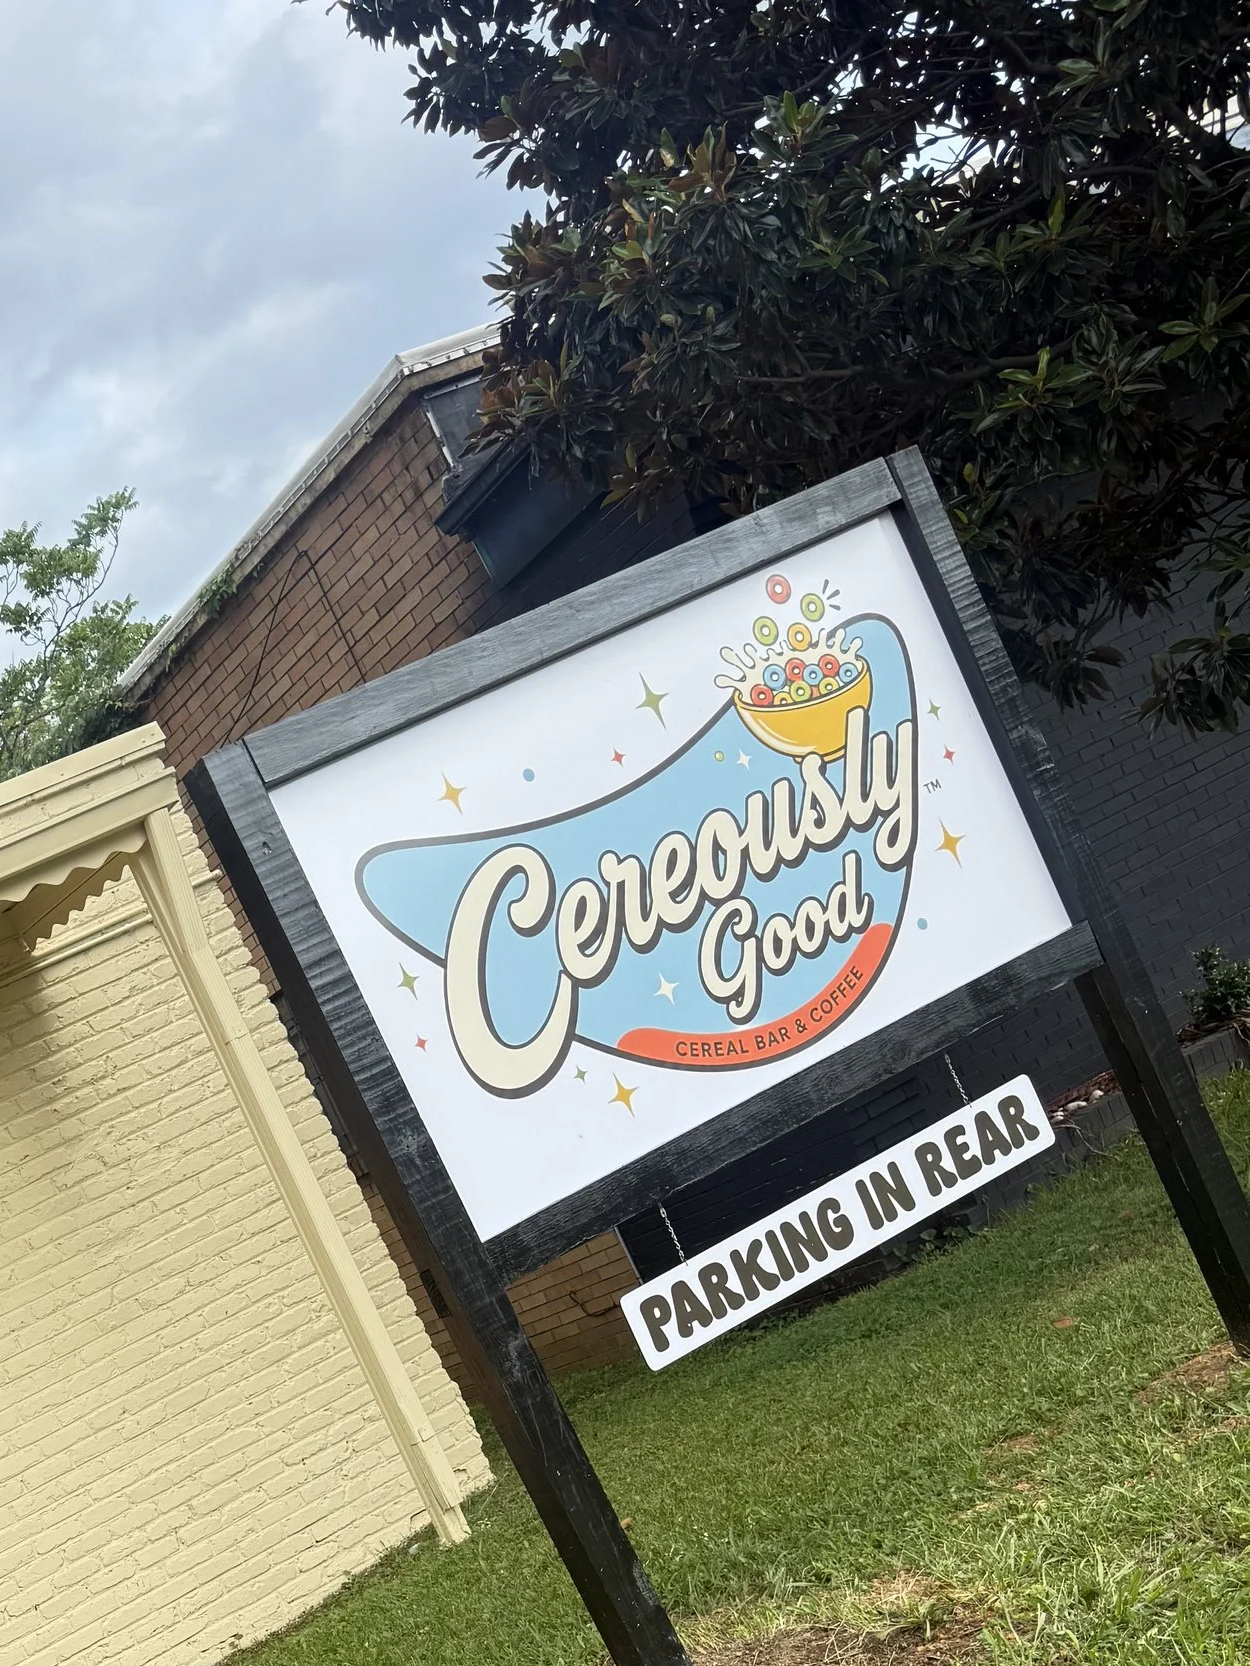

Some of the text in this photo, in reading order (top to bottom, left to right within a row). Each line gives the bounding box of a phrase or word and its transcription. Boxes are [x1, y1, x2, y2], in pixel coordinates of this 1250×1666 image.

[444, 705, 917, 1098] Cereously
[698, 850, 874, 1025] Good
[675, 965, 864, 1057] CEREAL BAR & COFFEE
[639, 1094, 1040, 1353] PARKING IN REAR
